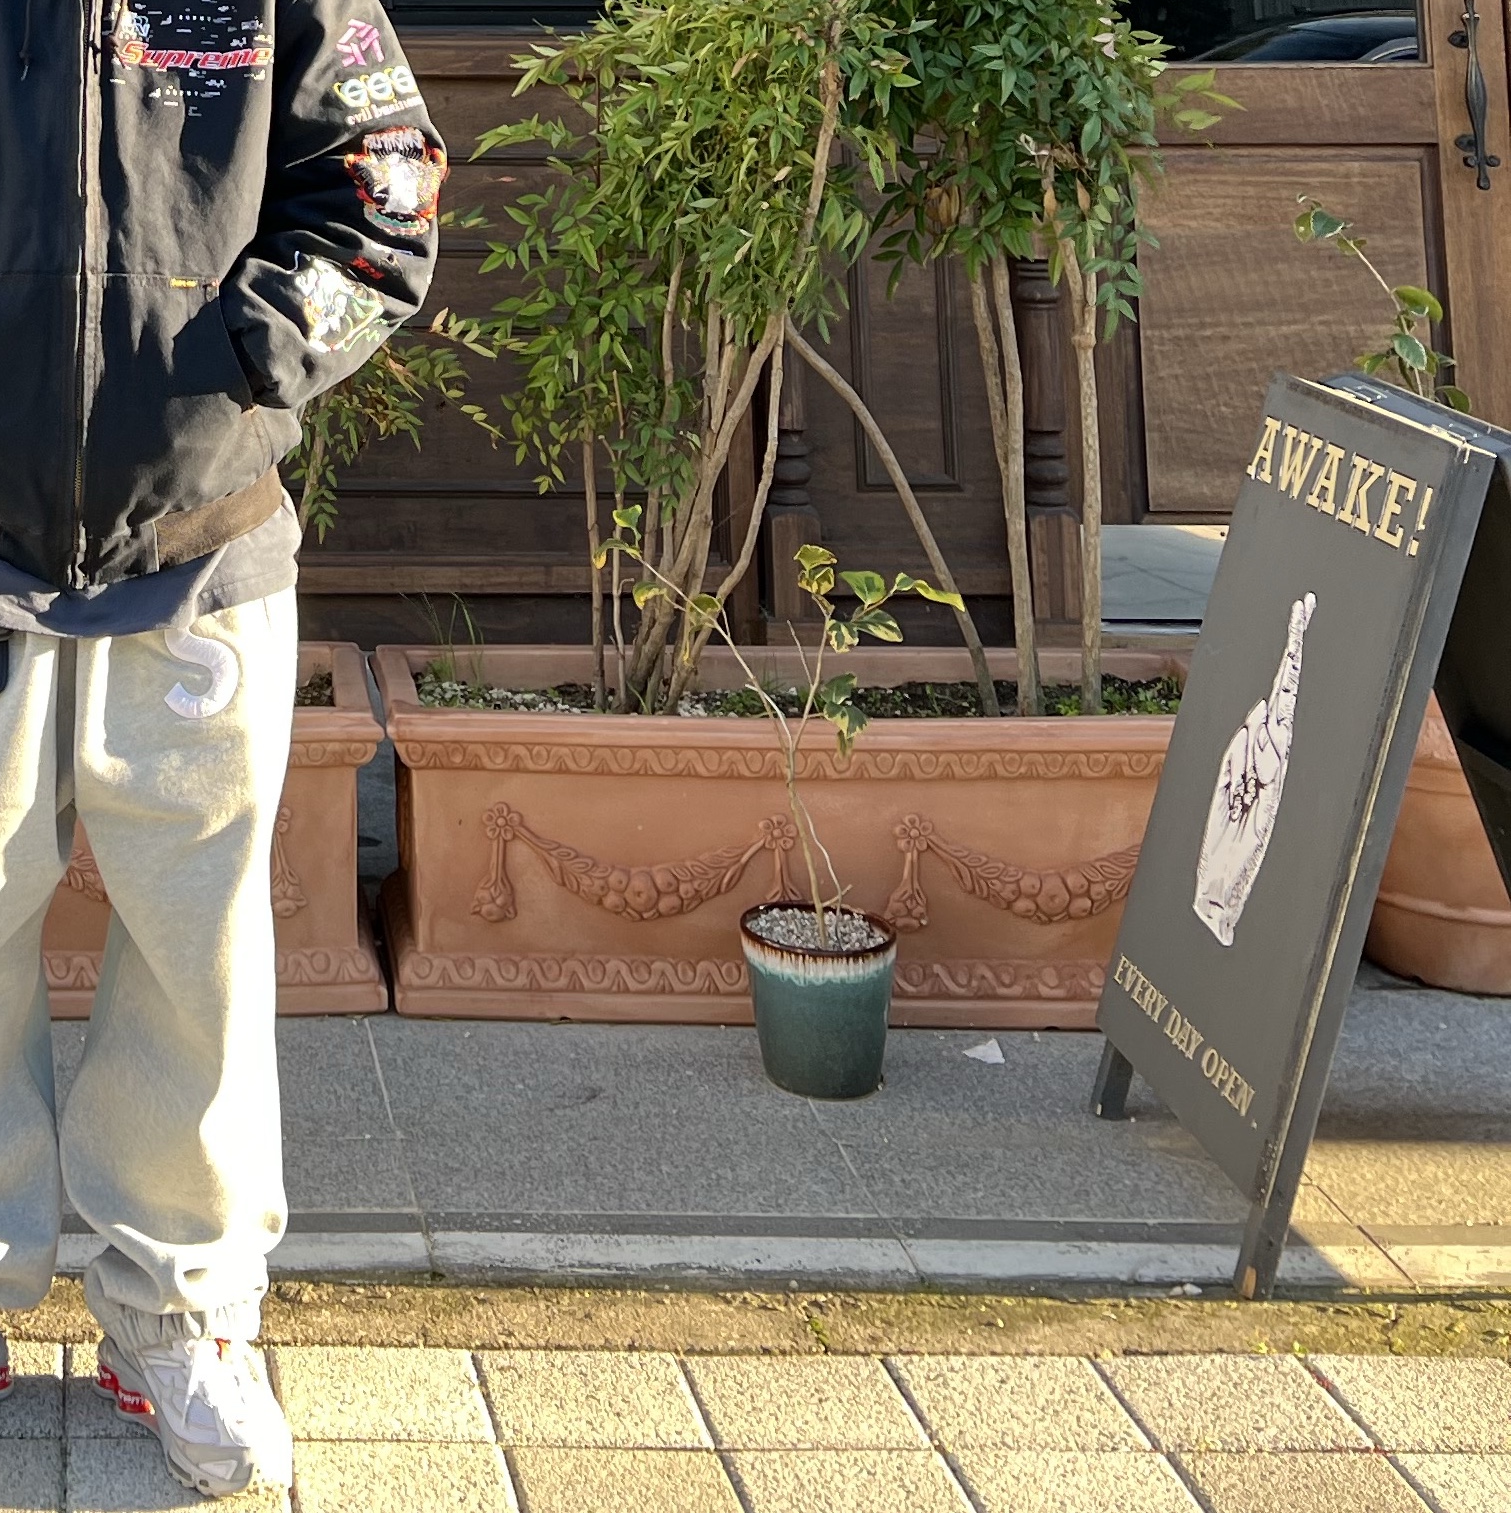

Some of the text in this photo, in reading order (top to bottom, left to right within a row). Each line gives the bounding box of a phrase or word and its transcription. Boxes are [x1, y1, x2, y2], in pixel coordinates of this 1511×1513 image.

[120, 41, 275, 73] Supreme
[1246, 415, 1435, 558] AWAKE!
[1113, 953, 1169, 1024] EVERY
[1163, 1005, 1205, 1061] DAY
